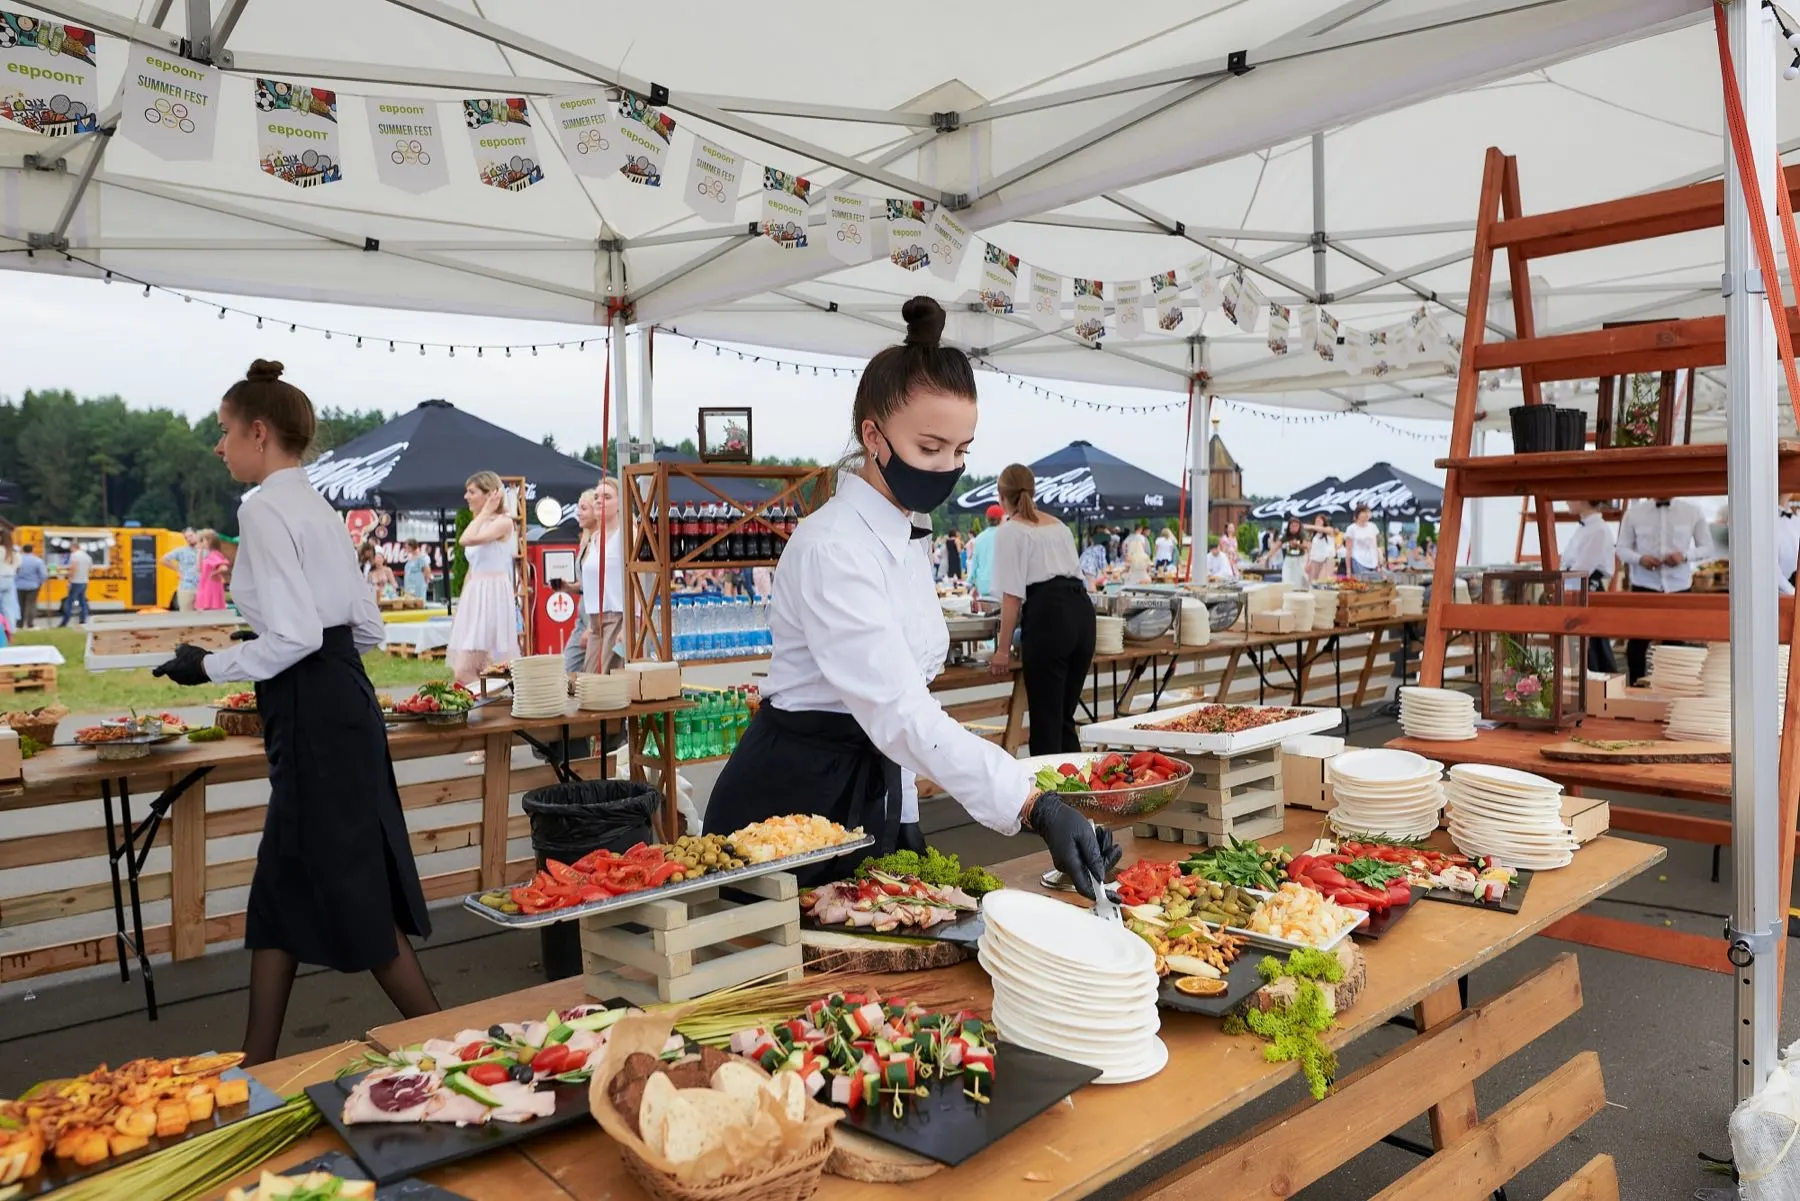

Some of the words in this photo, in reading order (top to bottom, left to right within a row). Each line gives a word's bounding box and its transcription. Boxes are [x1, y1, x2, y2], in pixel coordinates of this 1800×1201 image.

[7, 62, 85, 86] евроопт
[146, 56, 205, 81] евроопт
[137, 74, 182, 99] SUMMER
[184, 89, 209, 106] FEST
[379, 103, 425, 116] евроопт
[560, 97, 597, 110] евроопт
[378, 123, 412, 136] SUMMER
[414, 125, 433, 137] FEST
[561, 116, 591, 130] SUMMER
[591, 113, 607, 125] FEST
[268, 122, 329, 141] евроопт
[620, 126, 662, 155] евроопт
[479, 135, 527, 150] евроопт
[702, 144, 737, 165] евроопт
[696, 158, 721, 176] SUMMER
[721, 169, 736, 183] FEST
[768, 199, 803, 217] евроопт
